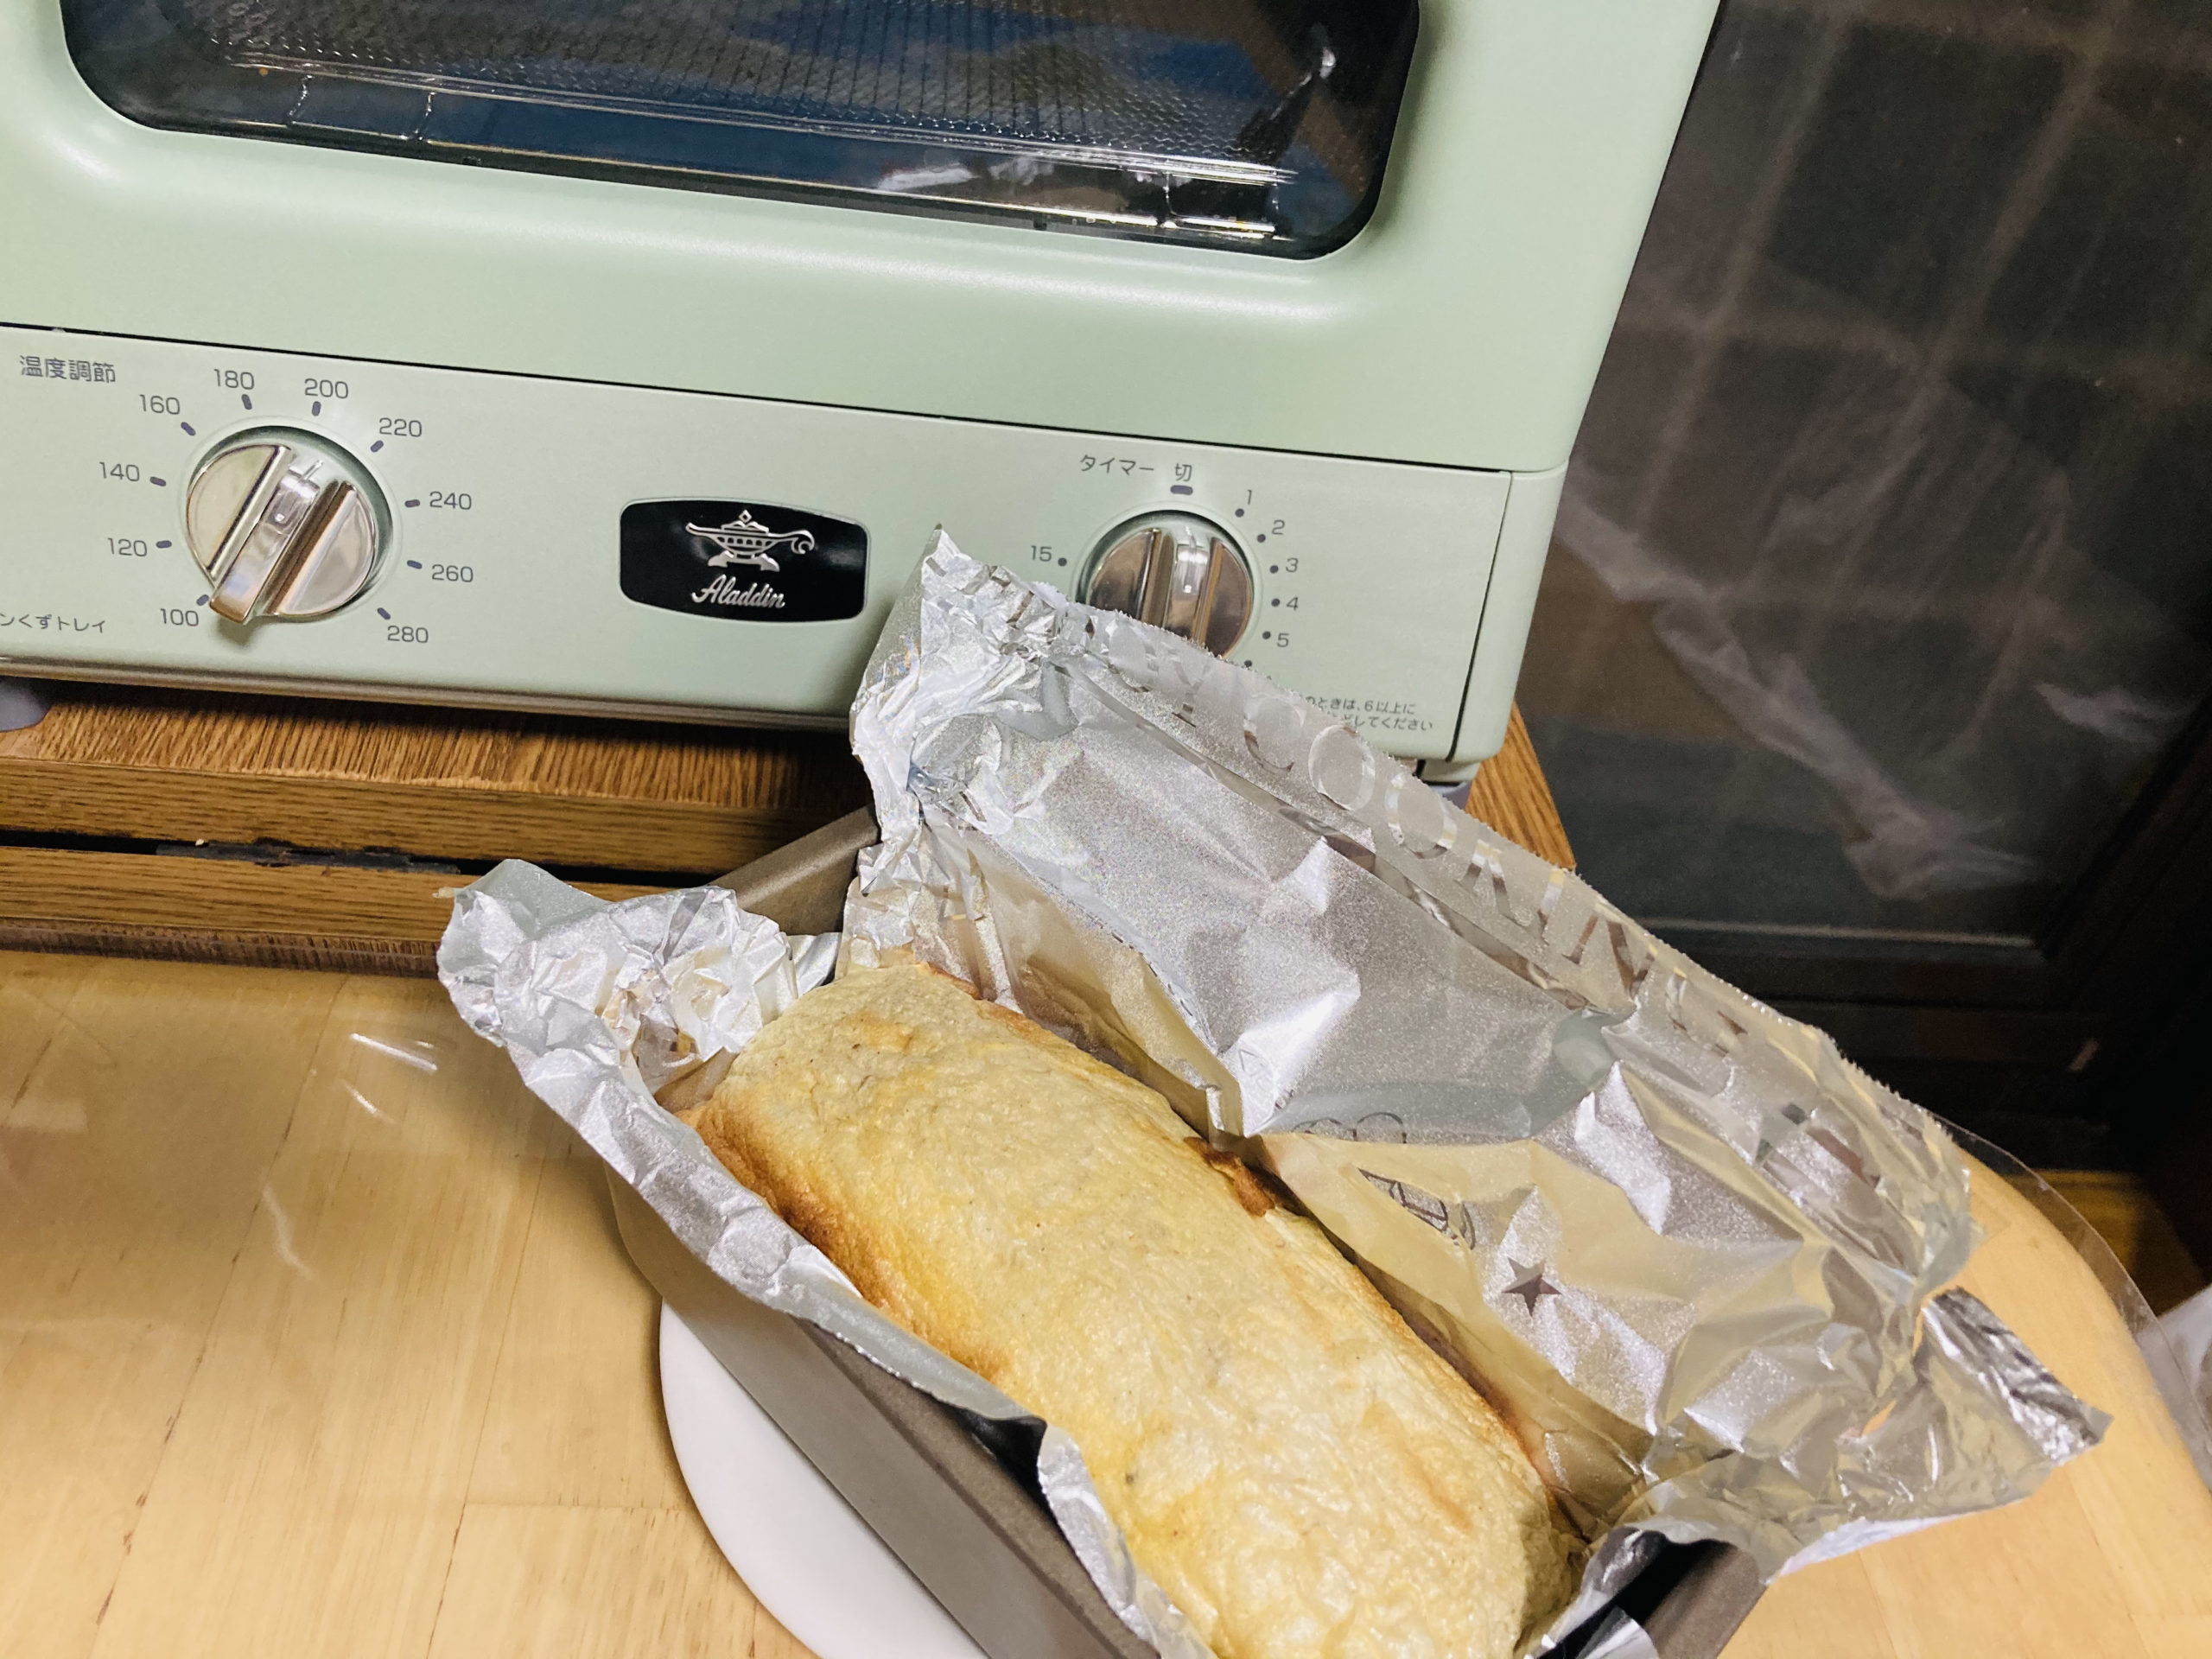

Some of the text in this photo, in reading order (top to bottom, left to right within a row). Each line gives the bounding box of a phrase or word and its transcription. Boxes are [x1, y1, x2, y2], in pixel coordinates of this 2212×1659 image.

[19, 355, 117, 384] 温度調節
[214, 369, 254, 390] 180
[304, 378, 348, 399] 200
[139, 395, 180, 416] 160
[379, 418, 423, 437] 220
[99, 462, 140, 482] 140
[1080, 454, 1154, 476] タイマー
[1175, 462, 1192, 481] 切
[429, 492, 472, 511] 240
[1246, 490, 1252, 504] 1
[1273, 520, 1285, 535] 2
[107, 537, 148, 557] 120
[1031, 546, 1052, 562] 15
[432, 564, 474, 583] 260
[1285, 558, 1299, 573] 3
[691, 574, 785, 609] Aladdin
[1287, 597, 1300, 610] 4
[160, 609, 199, 627] 100
[387, 626, 429, 644] 280
[1278, 633, 1289, 647] 5
